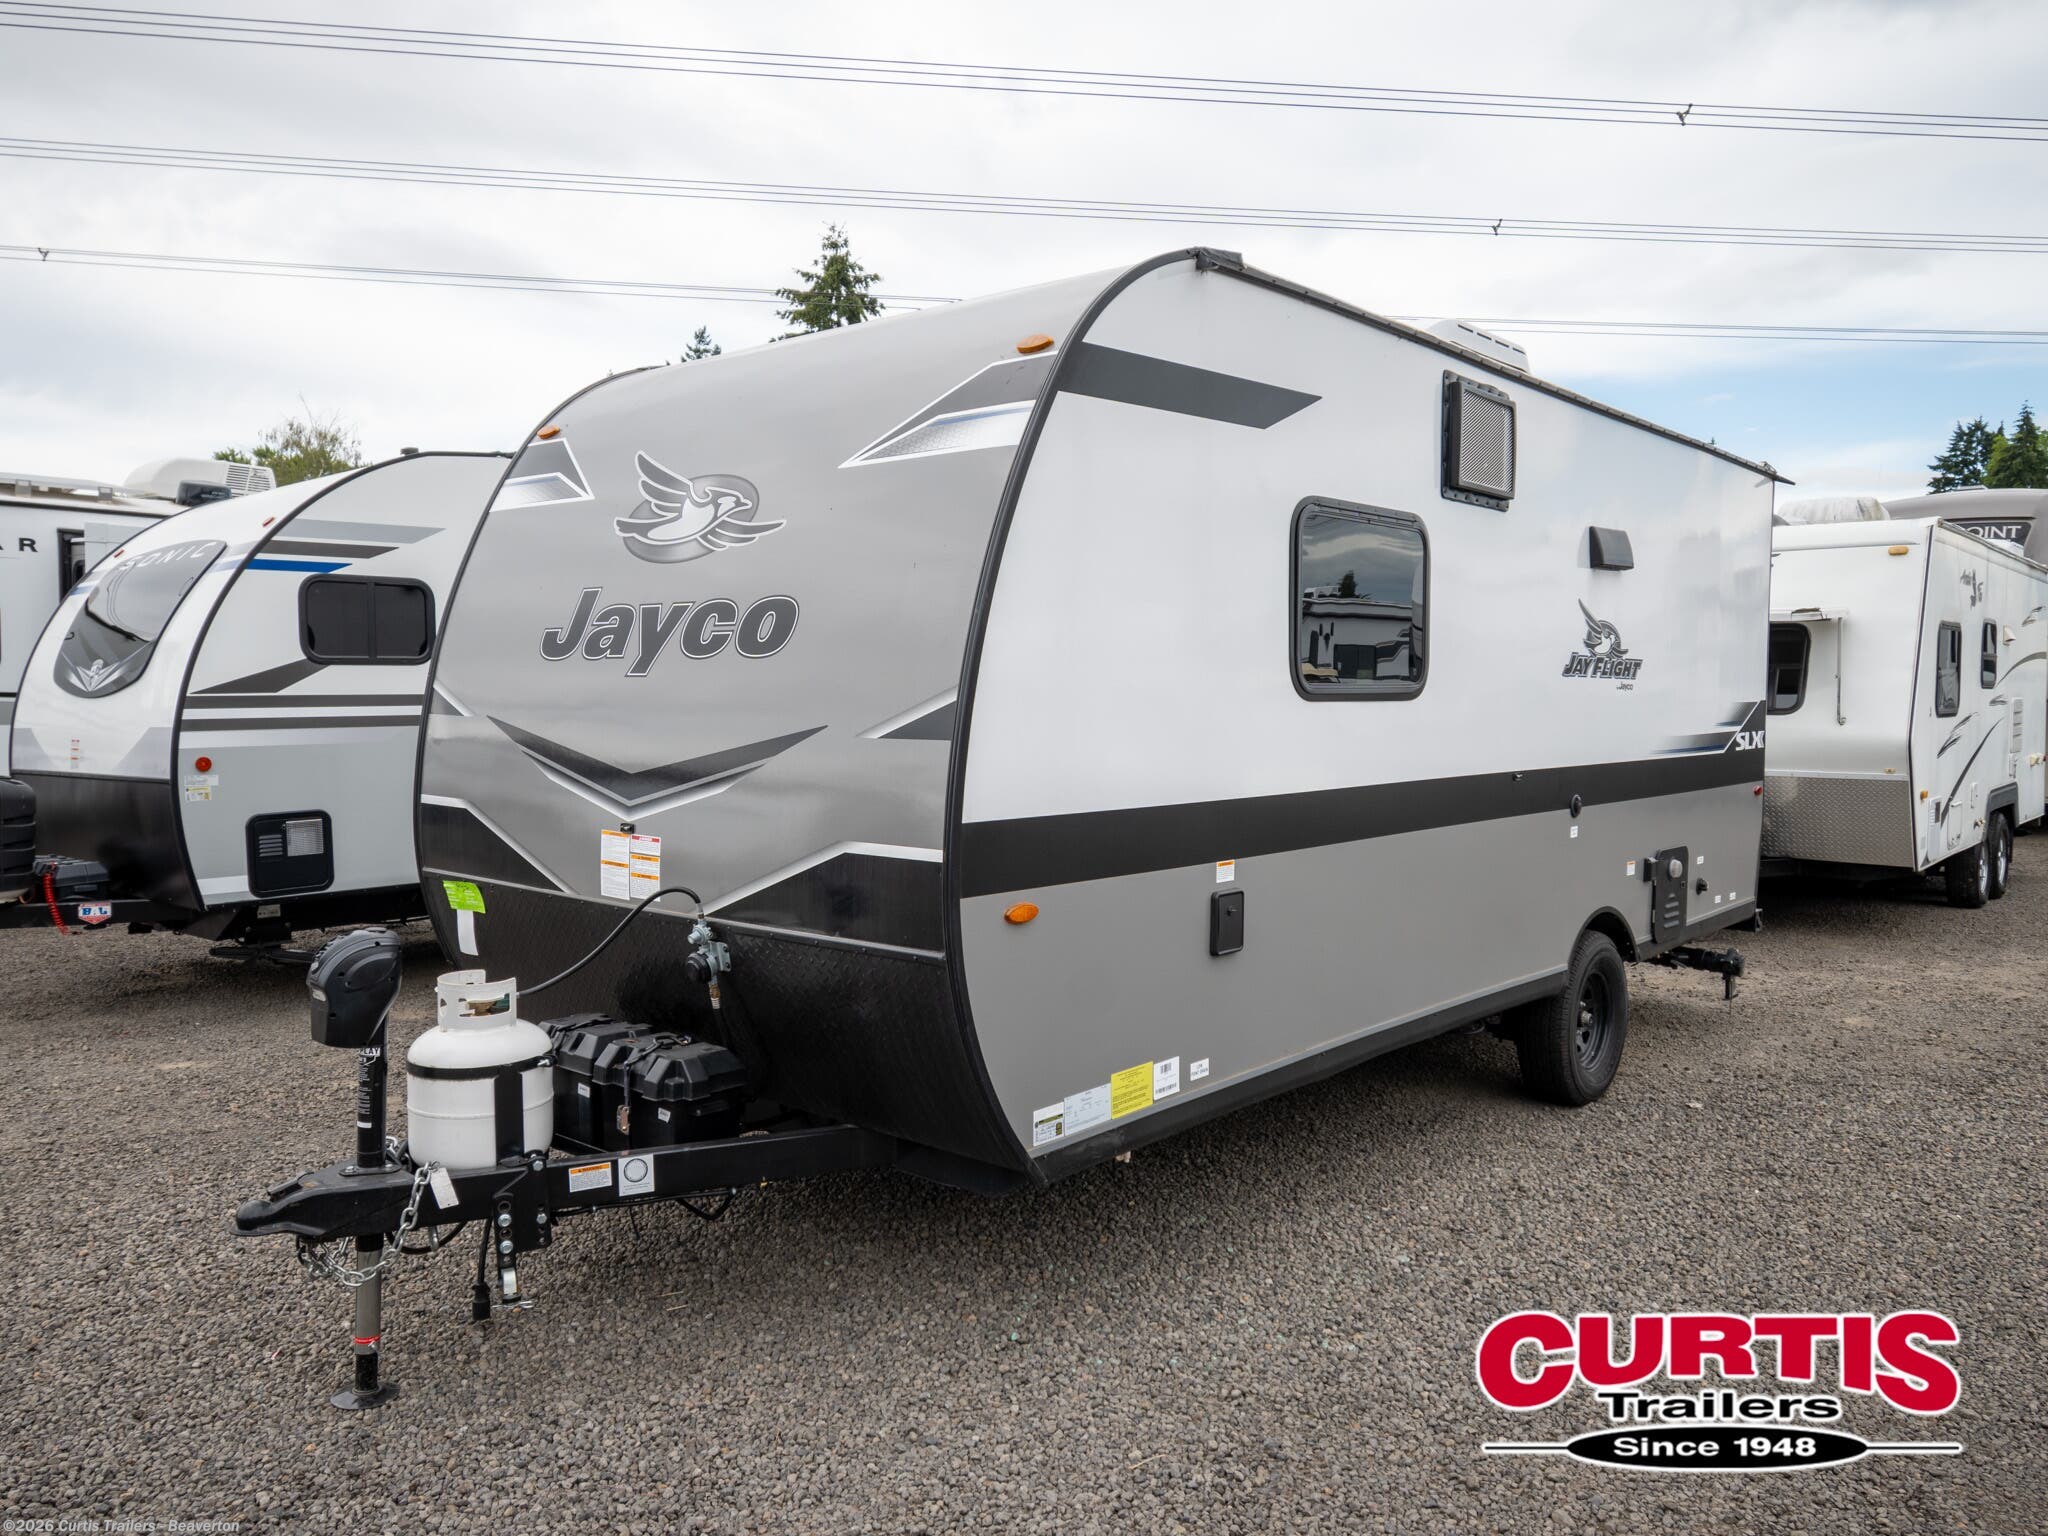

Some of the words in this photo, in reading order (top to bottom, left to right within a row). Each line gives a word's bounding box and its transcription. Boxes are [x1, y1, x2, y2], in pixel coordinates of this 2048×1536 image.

[540, 586, 800, 677] Jayco
[1562, 652, 1593, 677] JAY
[1590, 656, 1643, 680] FLIGHT
